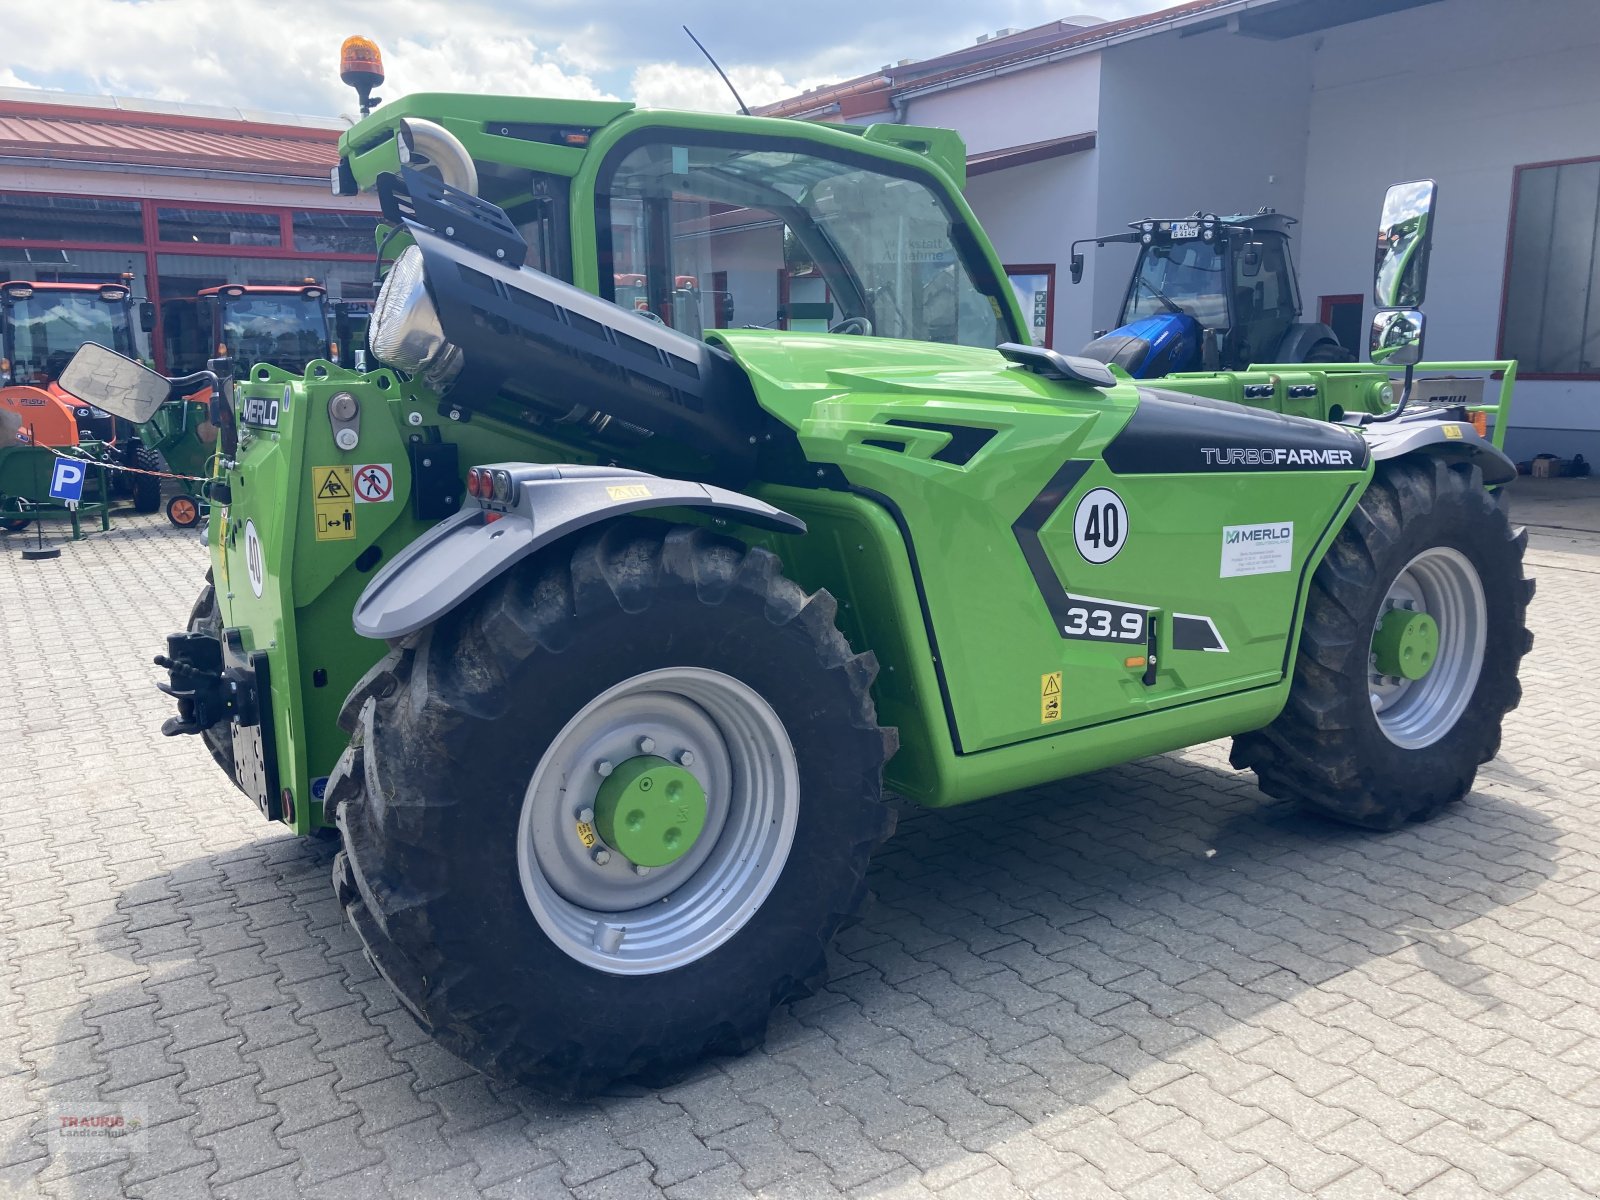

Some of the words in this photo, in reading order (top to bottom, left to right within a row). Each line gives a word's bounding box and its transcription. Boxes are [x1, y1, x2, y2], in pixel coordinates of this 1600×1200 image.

[883, 239, 943, 249] Wkstatt
[243, 398, 279, 426] MERLO
[1200, 447, 1354, 465] TURBOFARMER
[54, 464, 81, 492] P
[1084, 502, 1119, 549] 40
[1241, 527, 1290, 542] MERLO
[248, 535, 261, 584] 40
[1064, 607, 1143, 640] 33.9
